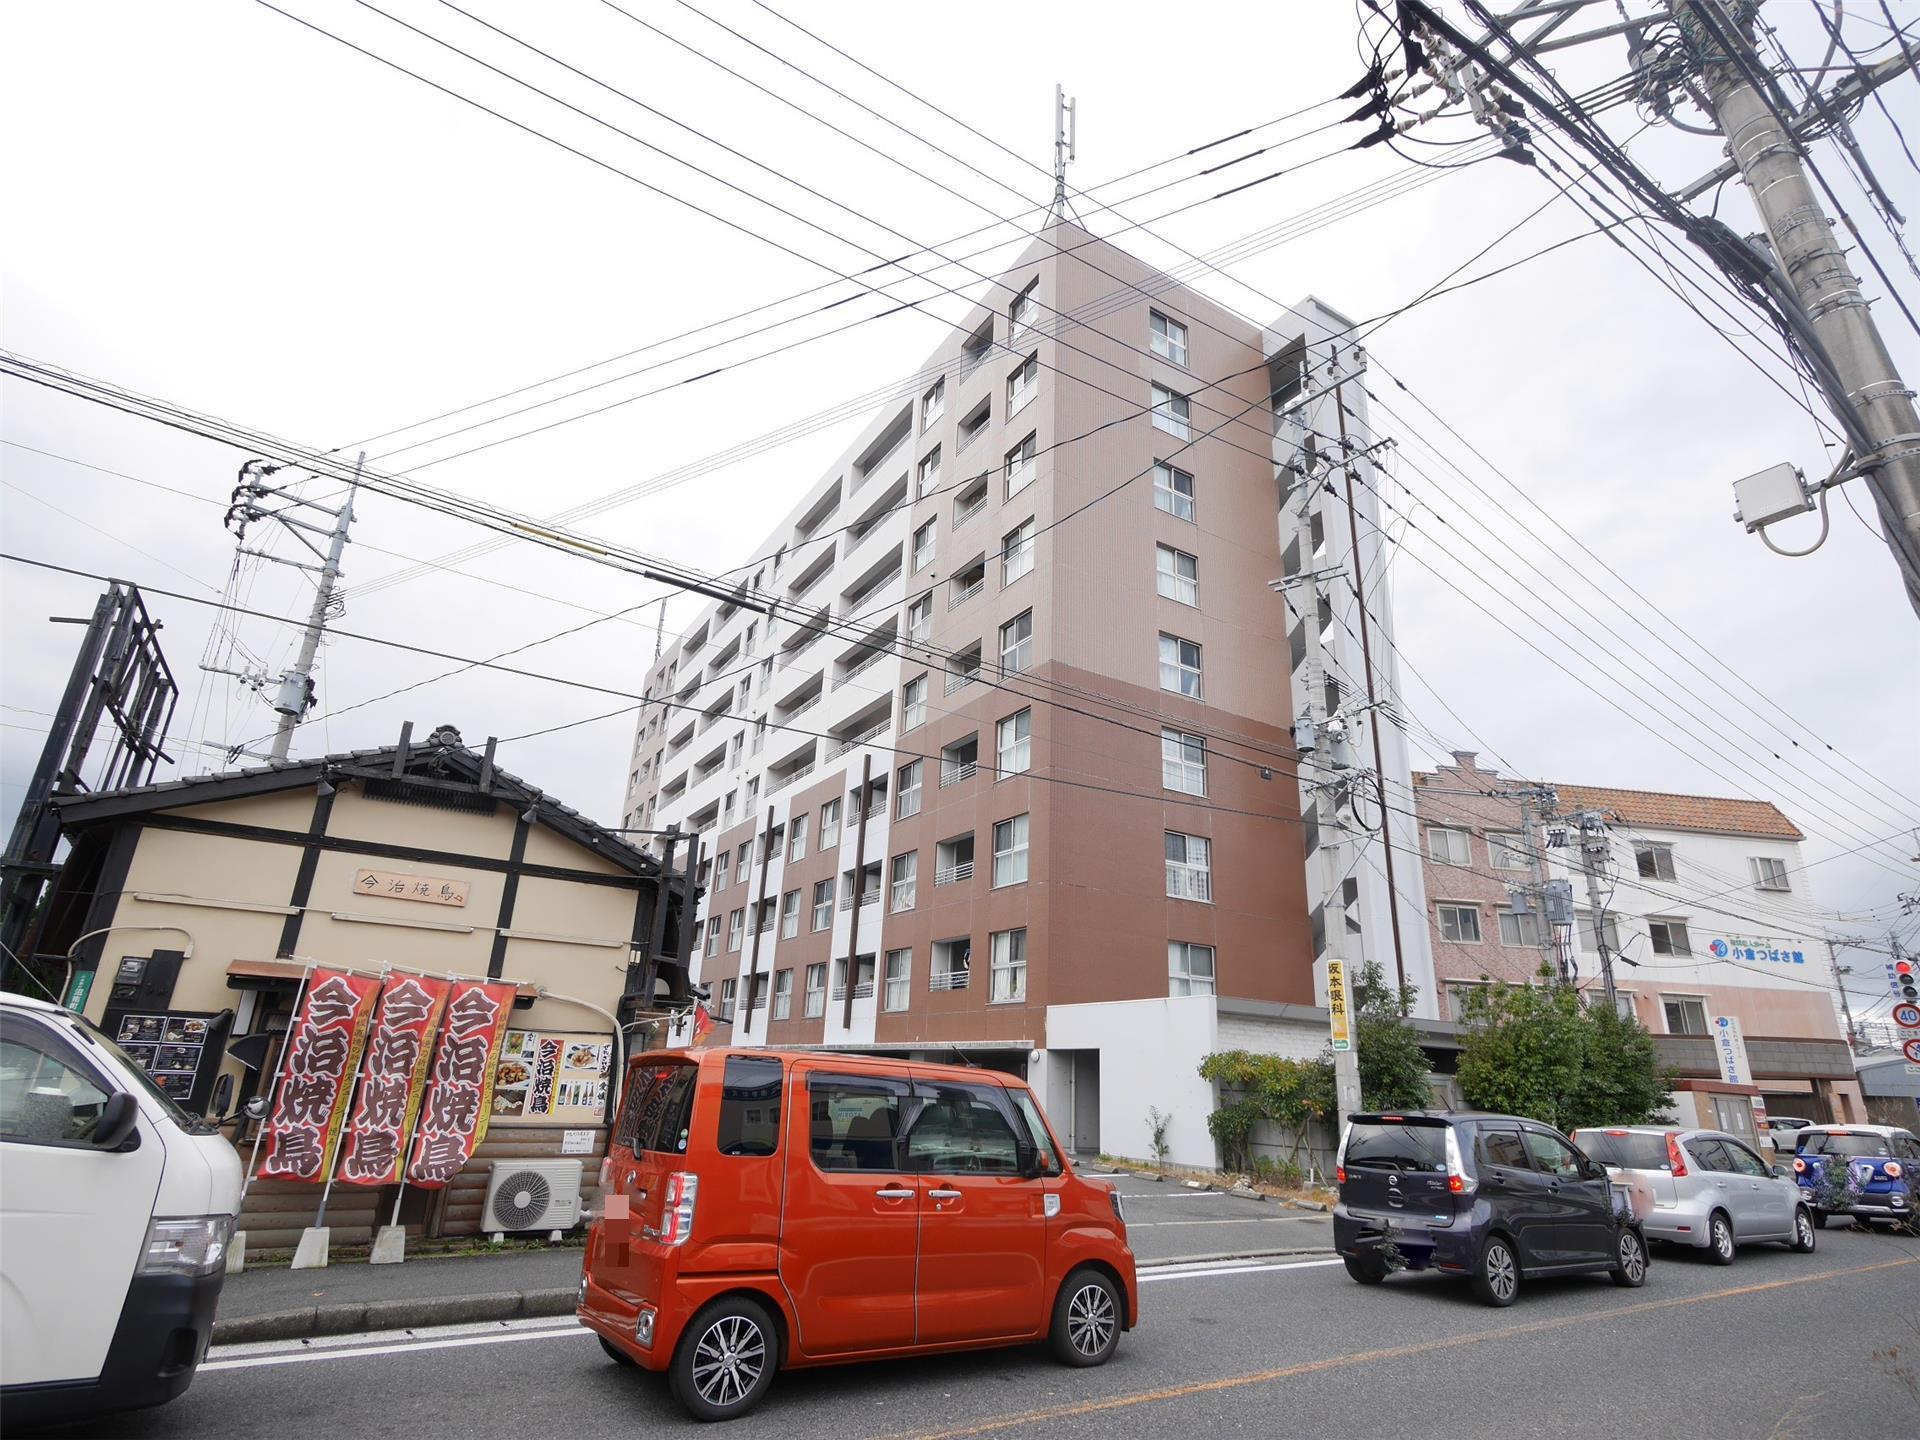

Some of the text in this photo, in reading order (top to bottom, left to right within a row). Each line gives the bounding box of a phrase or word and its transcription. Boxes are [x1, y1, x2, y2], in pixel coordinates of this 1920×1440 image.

[361, 874, 454, 901] 今治焼鳥
[1733, 947, 1804, 964] 小倉つばさ館
[1328, 963, 1344, 1016] 坂本眼科
[1900, 1009, 1918, 1022] 40
[266, 976, 361, 1178] 今治焼鳥
[345, 979, 435, 1179] 今治焼鳥
[531, 1040, 559, 1113] 今治焼鳥
[1719, 1028, 1739, 1083] 小倉つばさ館
[410, 987, 500, 1182] 今治焼鳥
